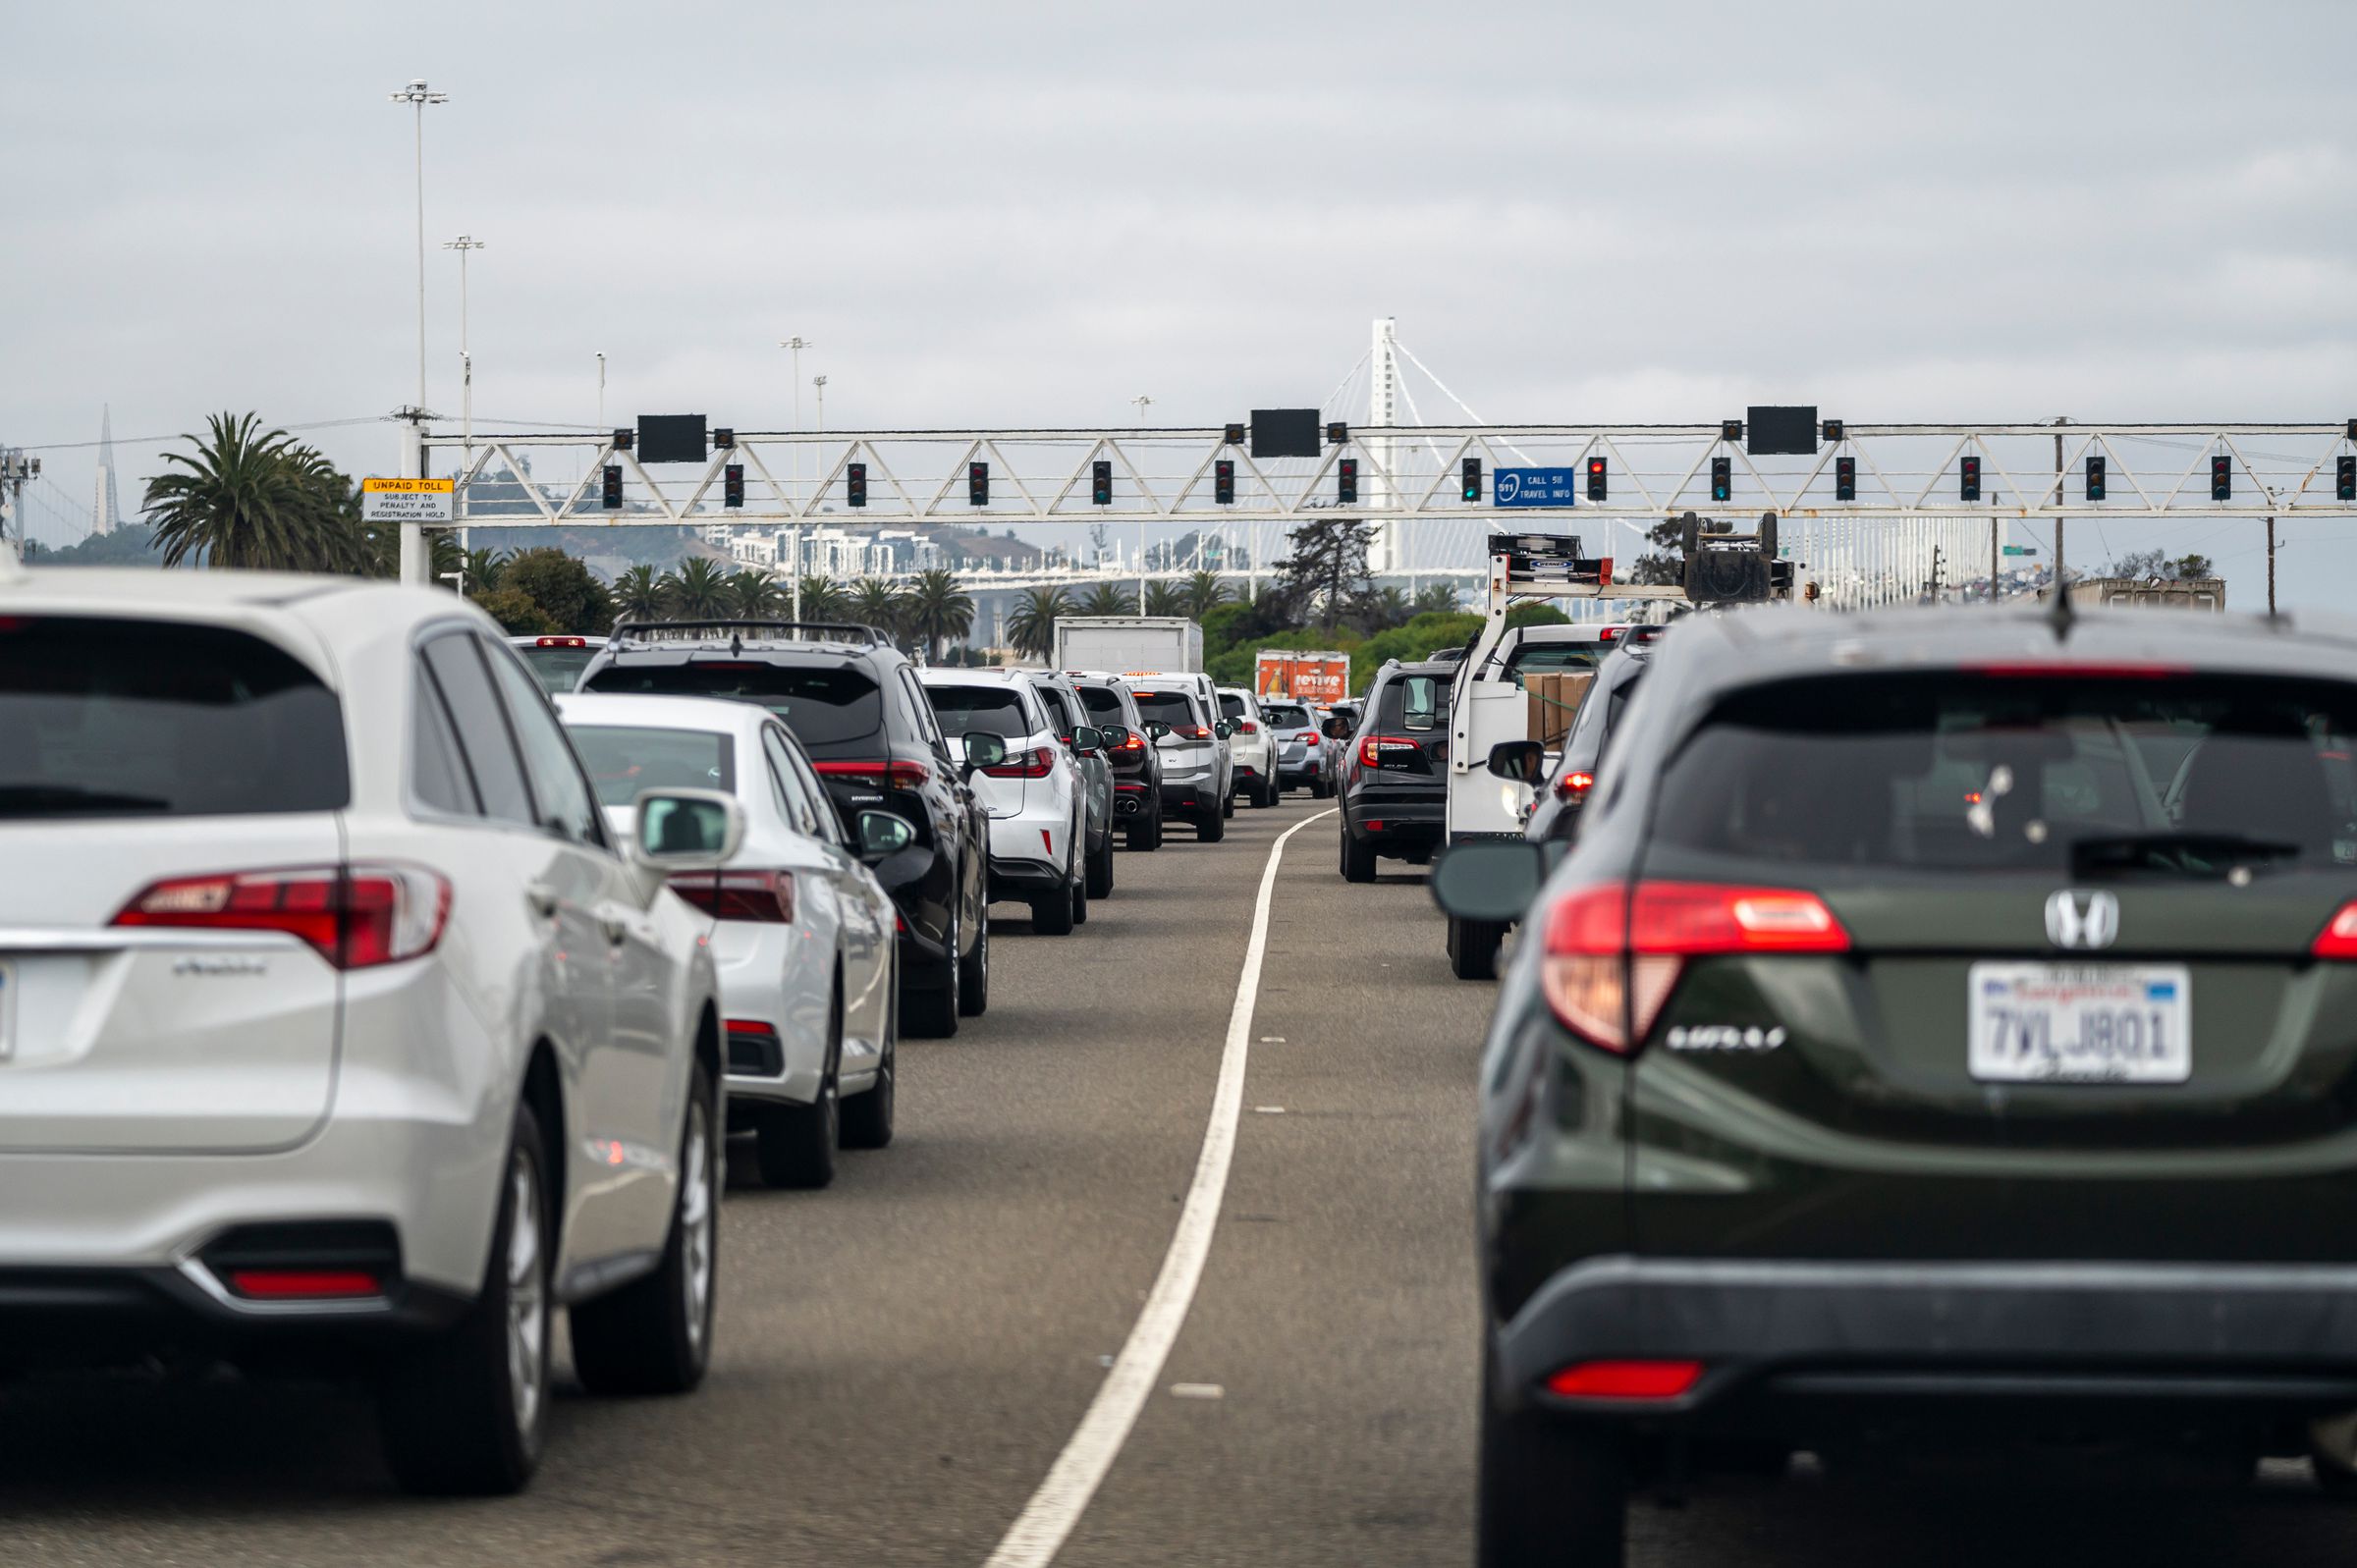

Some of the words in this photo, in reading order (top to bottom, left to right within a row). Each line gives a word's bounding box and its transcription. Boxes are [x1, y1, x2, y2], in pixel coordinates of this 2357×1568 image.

[1527, 476, 1547, 485] CALL
[1552, 475, 1563, 485] 511
[374, 481, 412, 490] UNPAID
[419, 481, 443, 490] TOLL
[1498, 483, 1513, 493] 511
[1520, 490, 1548, 499] TRAVEL
[1553, 490, 1570, 499] INFO
[1984, 1005, 2168, 1059] 7VLJ801
